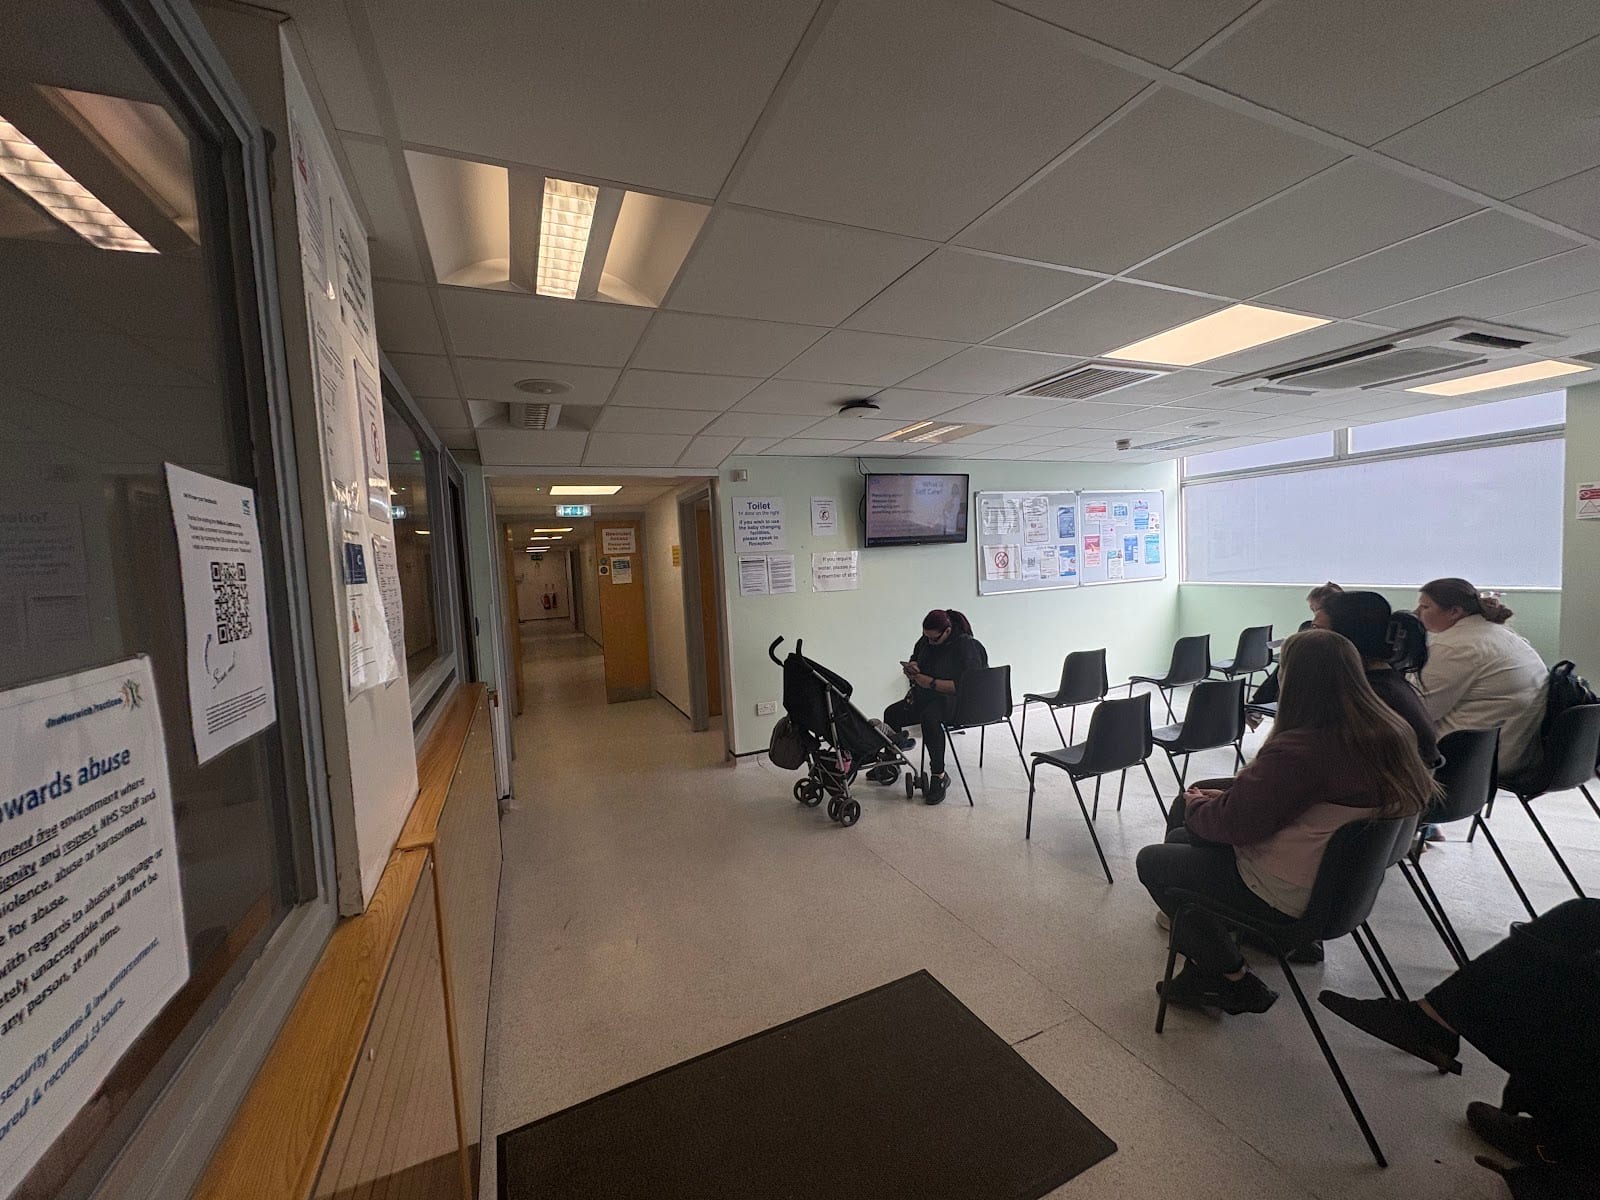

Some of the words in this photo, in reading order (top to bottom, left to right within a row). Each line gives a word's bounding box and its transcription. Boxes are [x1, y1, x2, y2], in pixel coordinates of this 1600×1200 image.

[747, 501, 771, 510] Toilet
[0, 771, 73, 823] wards
[78, 749, 131, 786] abuse
[37, 827, 58, 843] free
[60, 789, 119, 830] environment
[120, 777, 145, 796] where
[40, 844, 61, 868] and
[100, 809, 118, 829] NHS
[119, 797, 140, 817] Staff
[141, 788, 156, 806] and
[55, 857, 84, 883] abuse
[85, 848, 95, 863] or
[8, 919, 28, 939] for
[28, 920, 72, 958] regards
[72, 909, 83, 924] to
[85, 883, 116, 914] abusive
[117, 855, 154, 889] language
[154, 847, 163, 860] or
[31, 920, 99, 982] unacceptable
[100, 902, 115, 925] and
[117, 888, 131, 910] will
[132, 879, 147, 897] not
[148, 872, 158, 886] be
[0, 1007, 26, 1037] any
[72, 956, 83, 975] at
[83, 943, 99, 965] any
[0, 1047, 50, 1106] security
[52, 1015, 84, 1054] teams
[83, 1002, 93, 1020] &
[92, 986, 108, 1010] law
[32, 1087, 43, 1107] &
[44, 1032, 89, 1093] recorded
